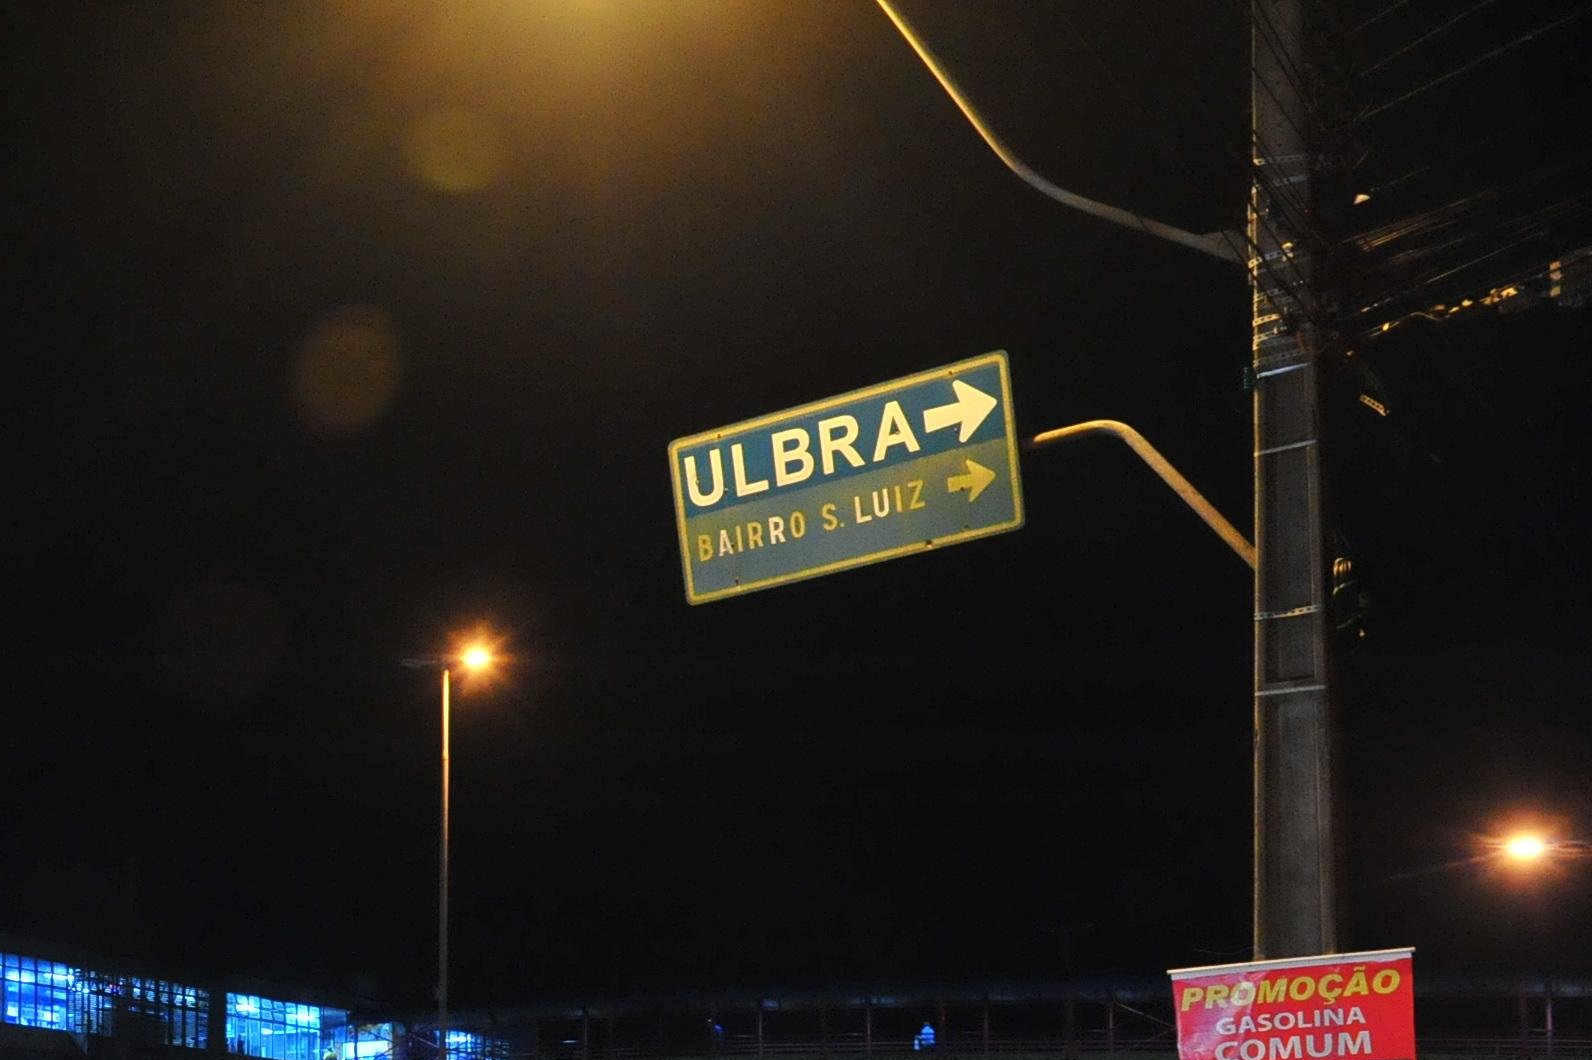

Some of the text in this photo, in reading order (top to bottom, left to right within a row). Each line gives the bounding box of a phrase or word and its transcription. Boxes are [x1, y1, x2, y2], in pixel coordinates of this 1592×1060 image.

[684, 400, 921, 507] ULBRA
[698, 479, 926, 562] BAIRRO S. LUIZ
[1180, 966, 1401, 1012] PROMOÇÃO
[1215, 1006, 1367, 1036] GASOLINA
